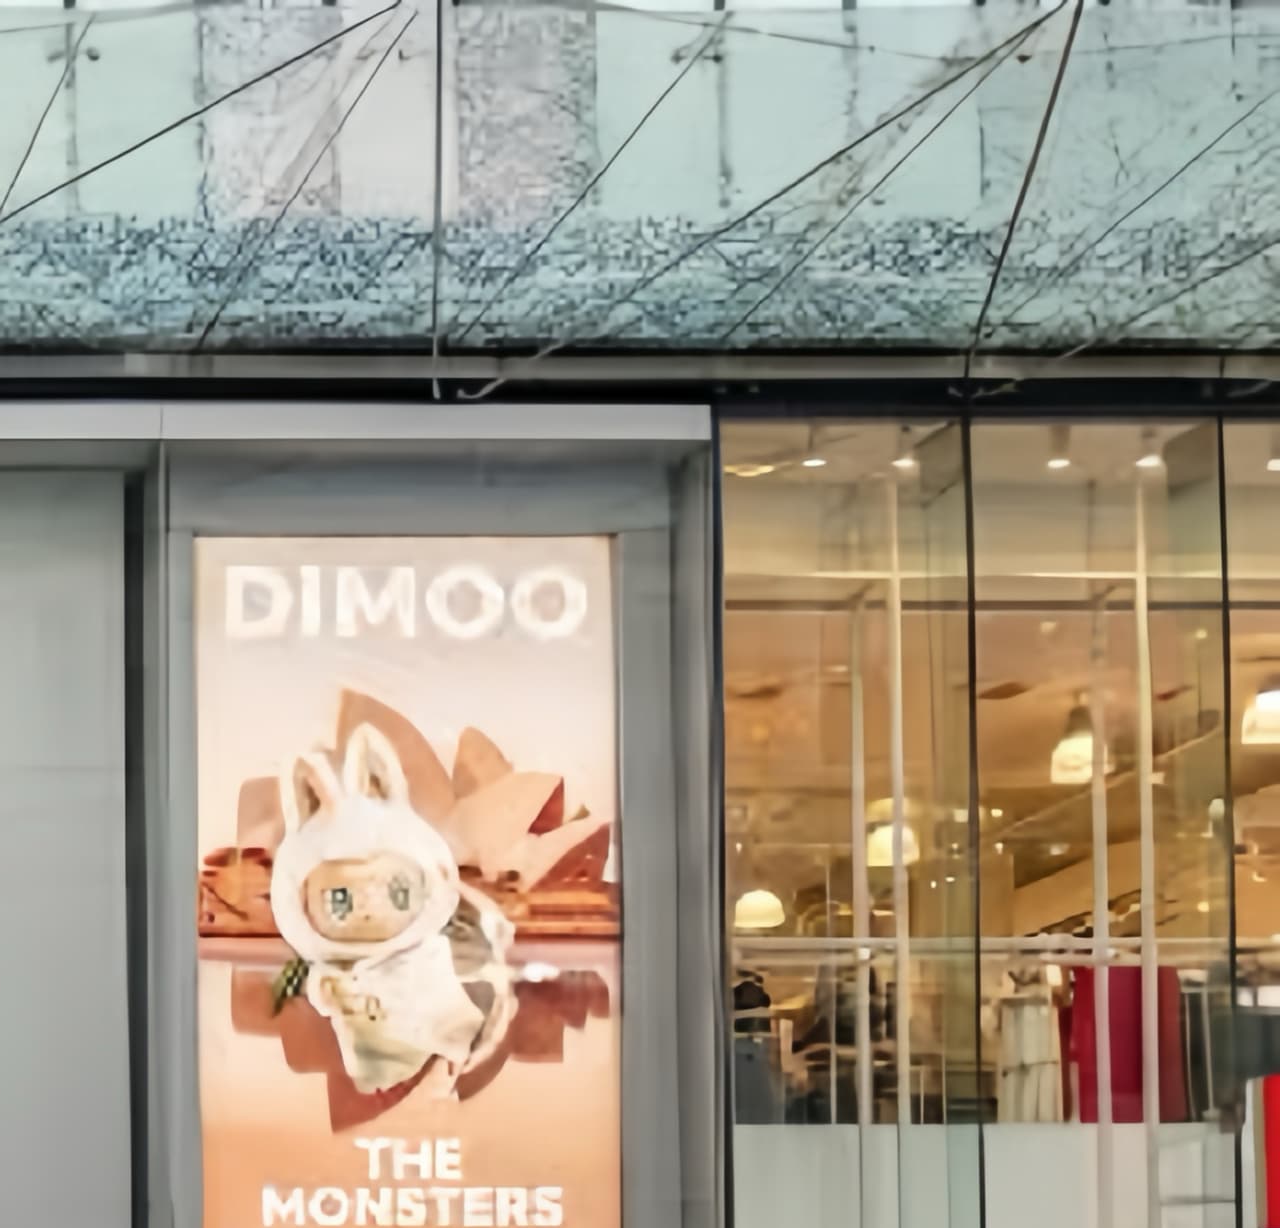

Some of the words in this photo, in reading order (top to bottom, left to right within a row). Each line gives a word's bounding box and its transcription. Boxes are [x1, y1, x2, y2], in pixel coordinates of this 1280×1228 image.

[224, 565, 588, 638] DIMOO
[354, 1136, 463, 1180] THE
[261, 1185, 564, 1228] MONSTERS
